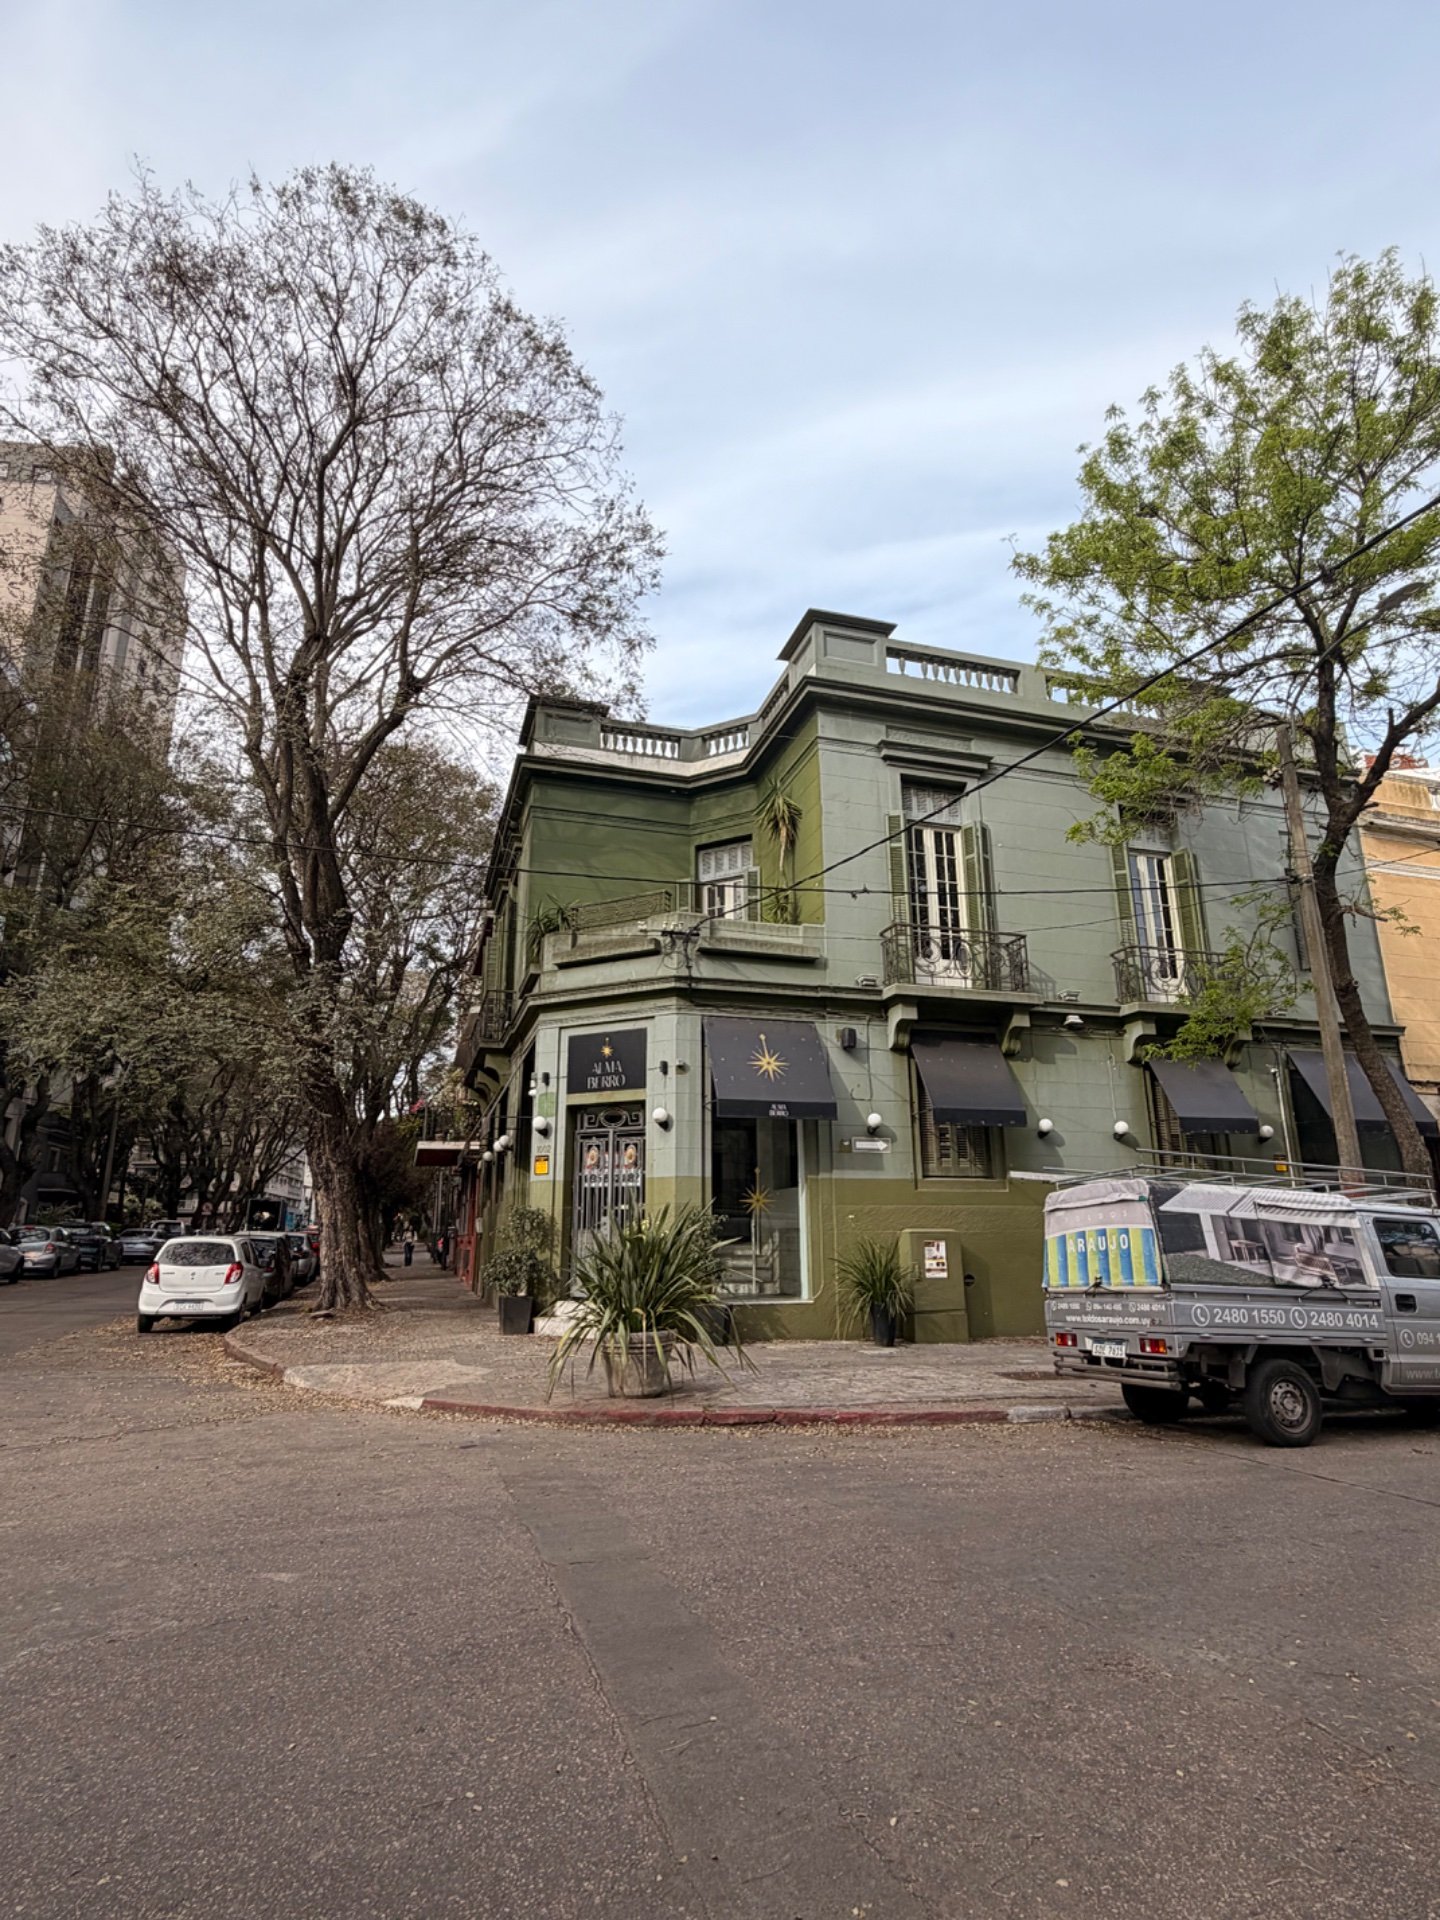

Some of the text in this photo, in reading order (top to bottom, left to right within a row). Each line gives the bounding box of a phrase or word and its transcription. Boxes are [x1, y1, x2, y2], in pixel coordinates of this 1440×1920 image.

[587, 1074, 626, 1089] BERRO
[1068, 1234, 1129, 1253] ARAUJO
[1213, 1308, 1286, 1325] 2480 1550
[1310, 1311, 1379, 1329] 2480 4014
[1416, 1332, 1434, 1345] 094
